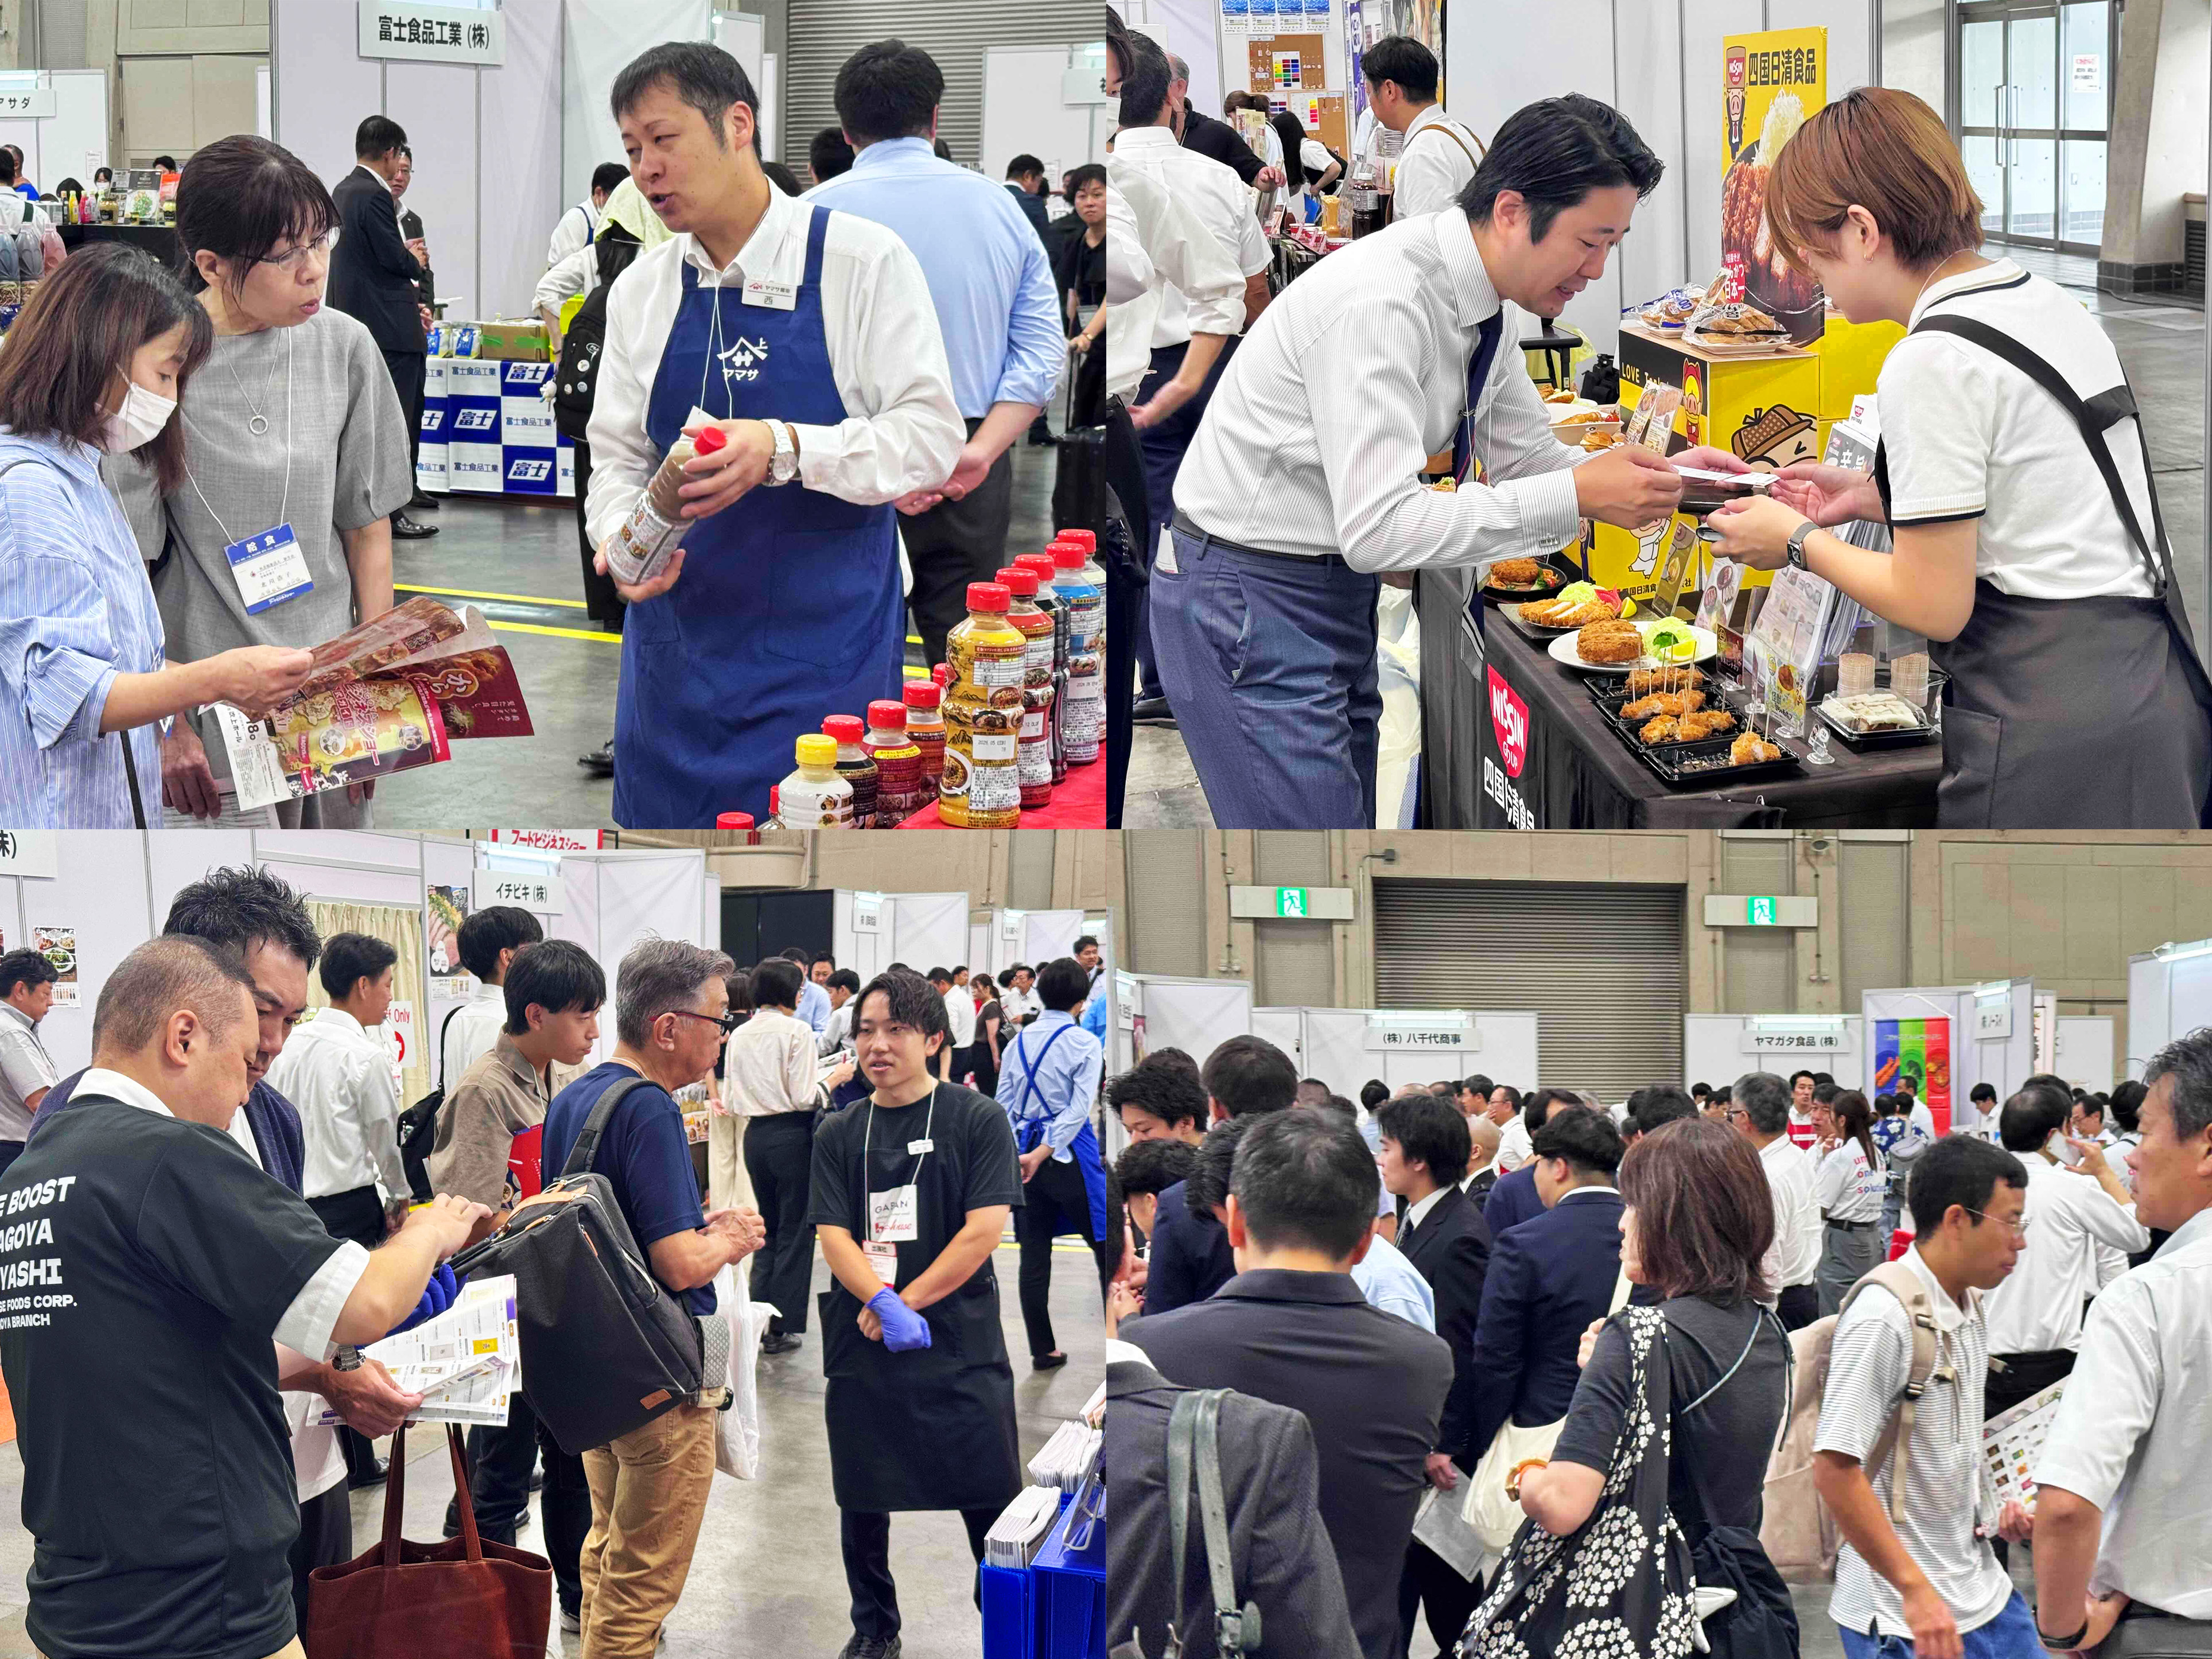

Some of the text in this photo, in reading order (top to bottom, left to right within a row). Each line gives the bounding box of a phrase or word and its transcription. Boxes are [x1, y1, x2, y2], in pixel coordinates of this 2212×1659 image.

[379, 15, 489, 49] 富士食品工業 (株)
[1729, 59, 1743, 75] NISSIN
[1748, 47, 1816, 86] 四国日清食品
[452, 366, 496, 376] 富士食品工業
[509, 365, 545, 380] 富士
[722, 368, 759, 381] ヤマサ
[1622, 362, 1640, 384] LOVE
[458, 411, 492, 426] 富士
[506, 417, 552, 426] 富士食品工業
[454, 462, 499, 473] 富士食品工業
[512, 462, 548, 477] 富士
[1623, 583, 1657, 595] 国日清食
[1493, 685, 1524, 752] NISSIN
[512, 830, 586, 850] フードビジネスショー
[496, 883, 547, 903] イチビキ (株)
[394, 1008, 410, 1023] Only
[1383, 1033, 1461, 1044] (株) 八千代商事
[1755, 1036, 1838, 1047] ヤマガタ食品 (株)
[7, 1176, 76, 1215] BOOST
[7, 1296, 31, 1312] FOODS
[33, 1295, 77, 1309] CORP.
[12, 1314, 50, 1328] BRANCH
